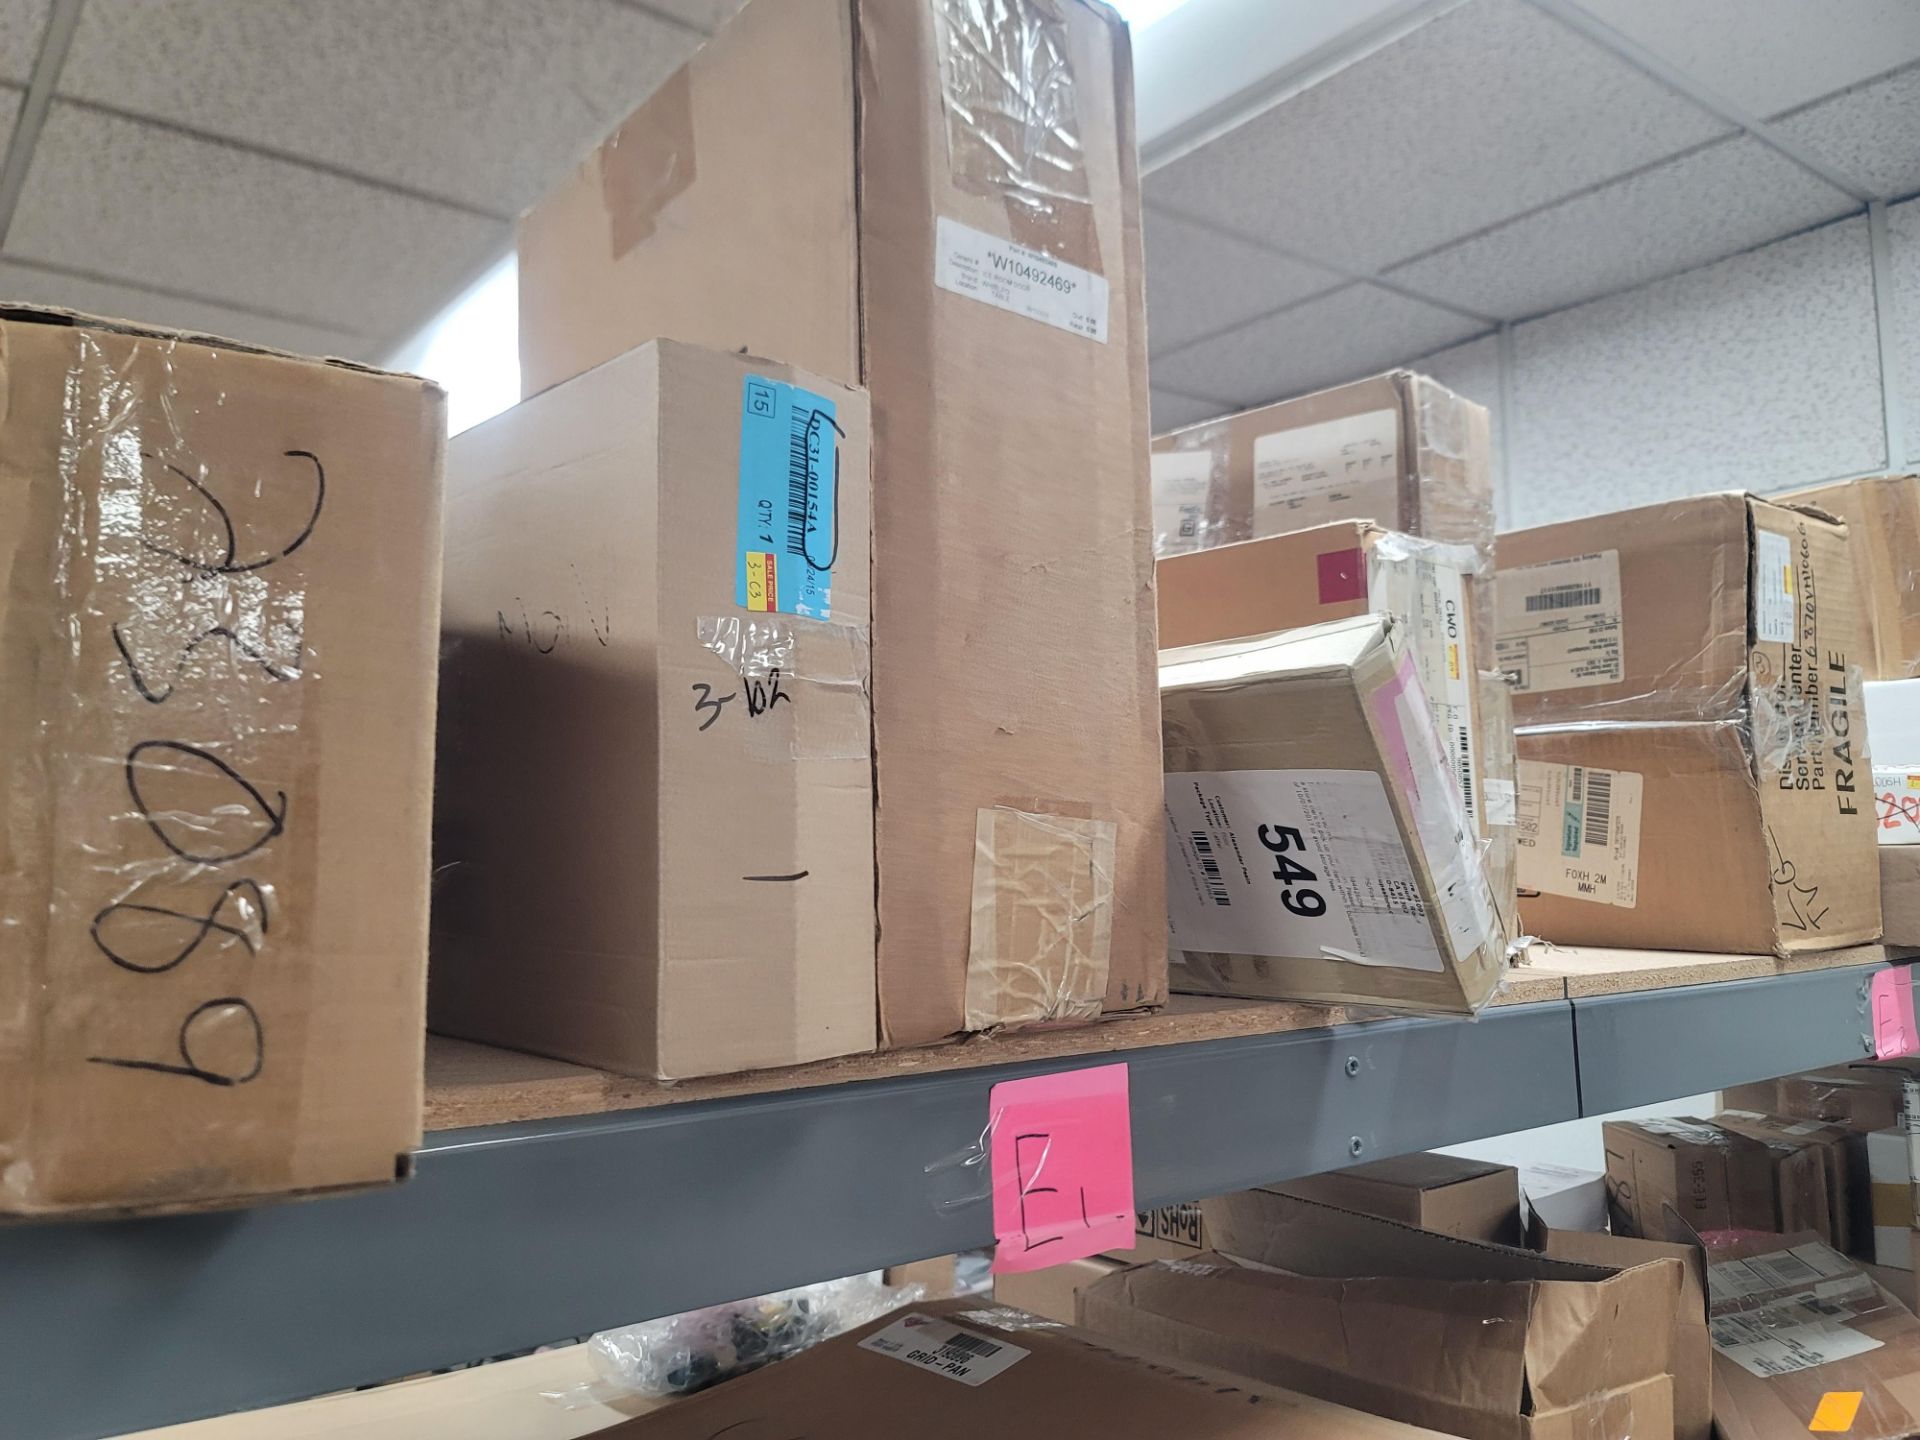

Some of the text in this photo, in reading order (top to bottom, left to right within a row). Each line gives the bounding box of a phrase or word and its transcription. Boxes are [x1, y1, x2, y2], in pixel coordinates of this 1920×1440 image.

[754, 387, 768, 413] 15
[759, 532, 773, 544] 1
[805, 554, 815, 596] 0/24/15
[1444, 600, 1458, 638] CWO
[1828, 651, 1858, 815] FRAGILE
[1812, 749, 1825, 790] Part
[1214, 795, 1231, 829] Customer:
[1258, 823, 1327, 917] 549
